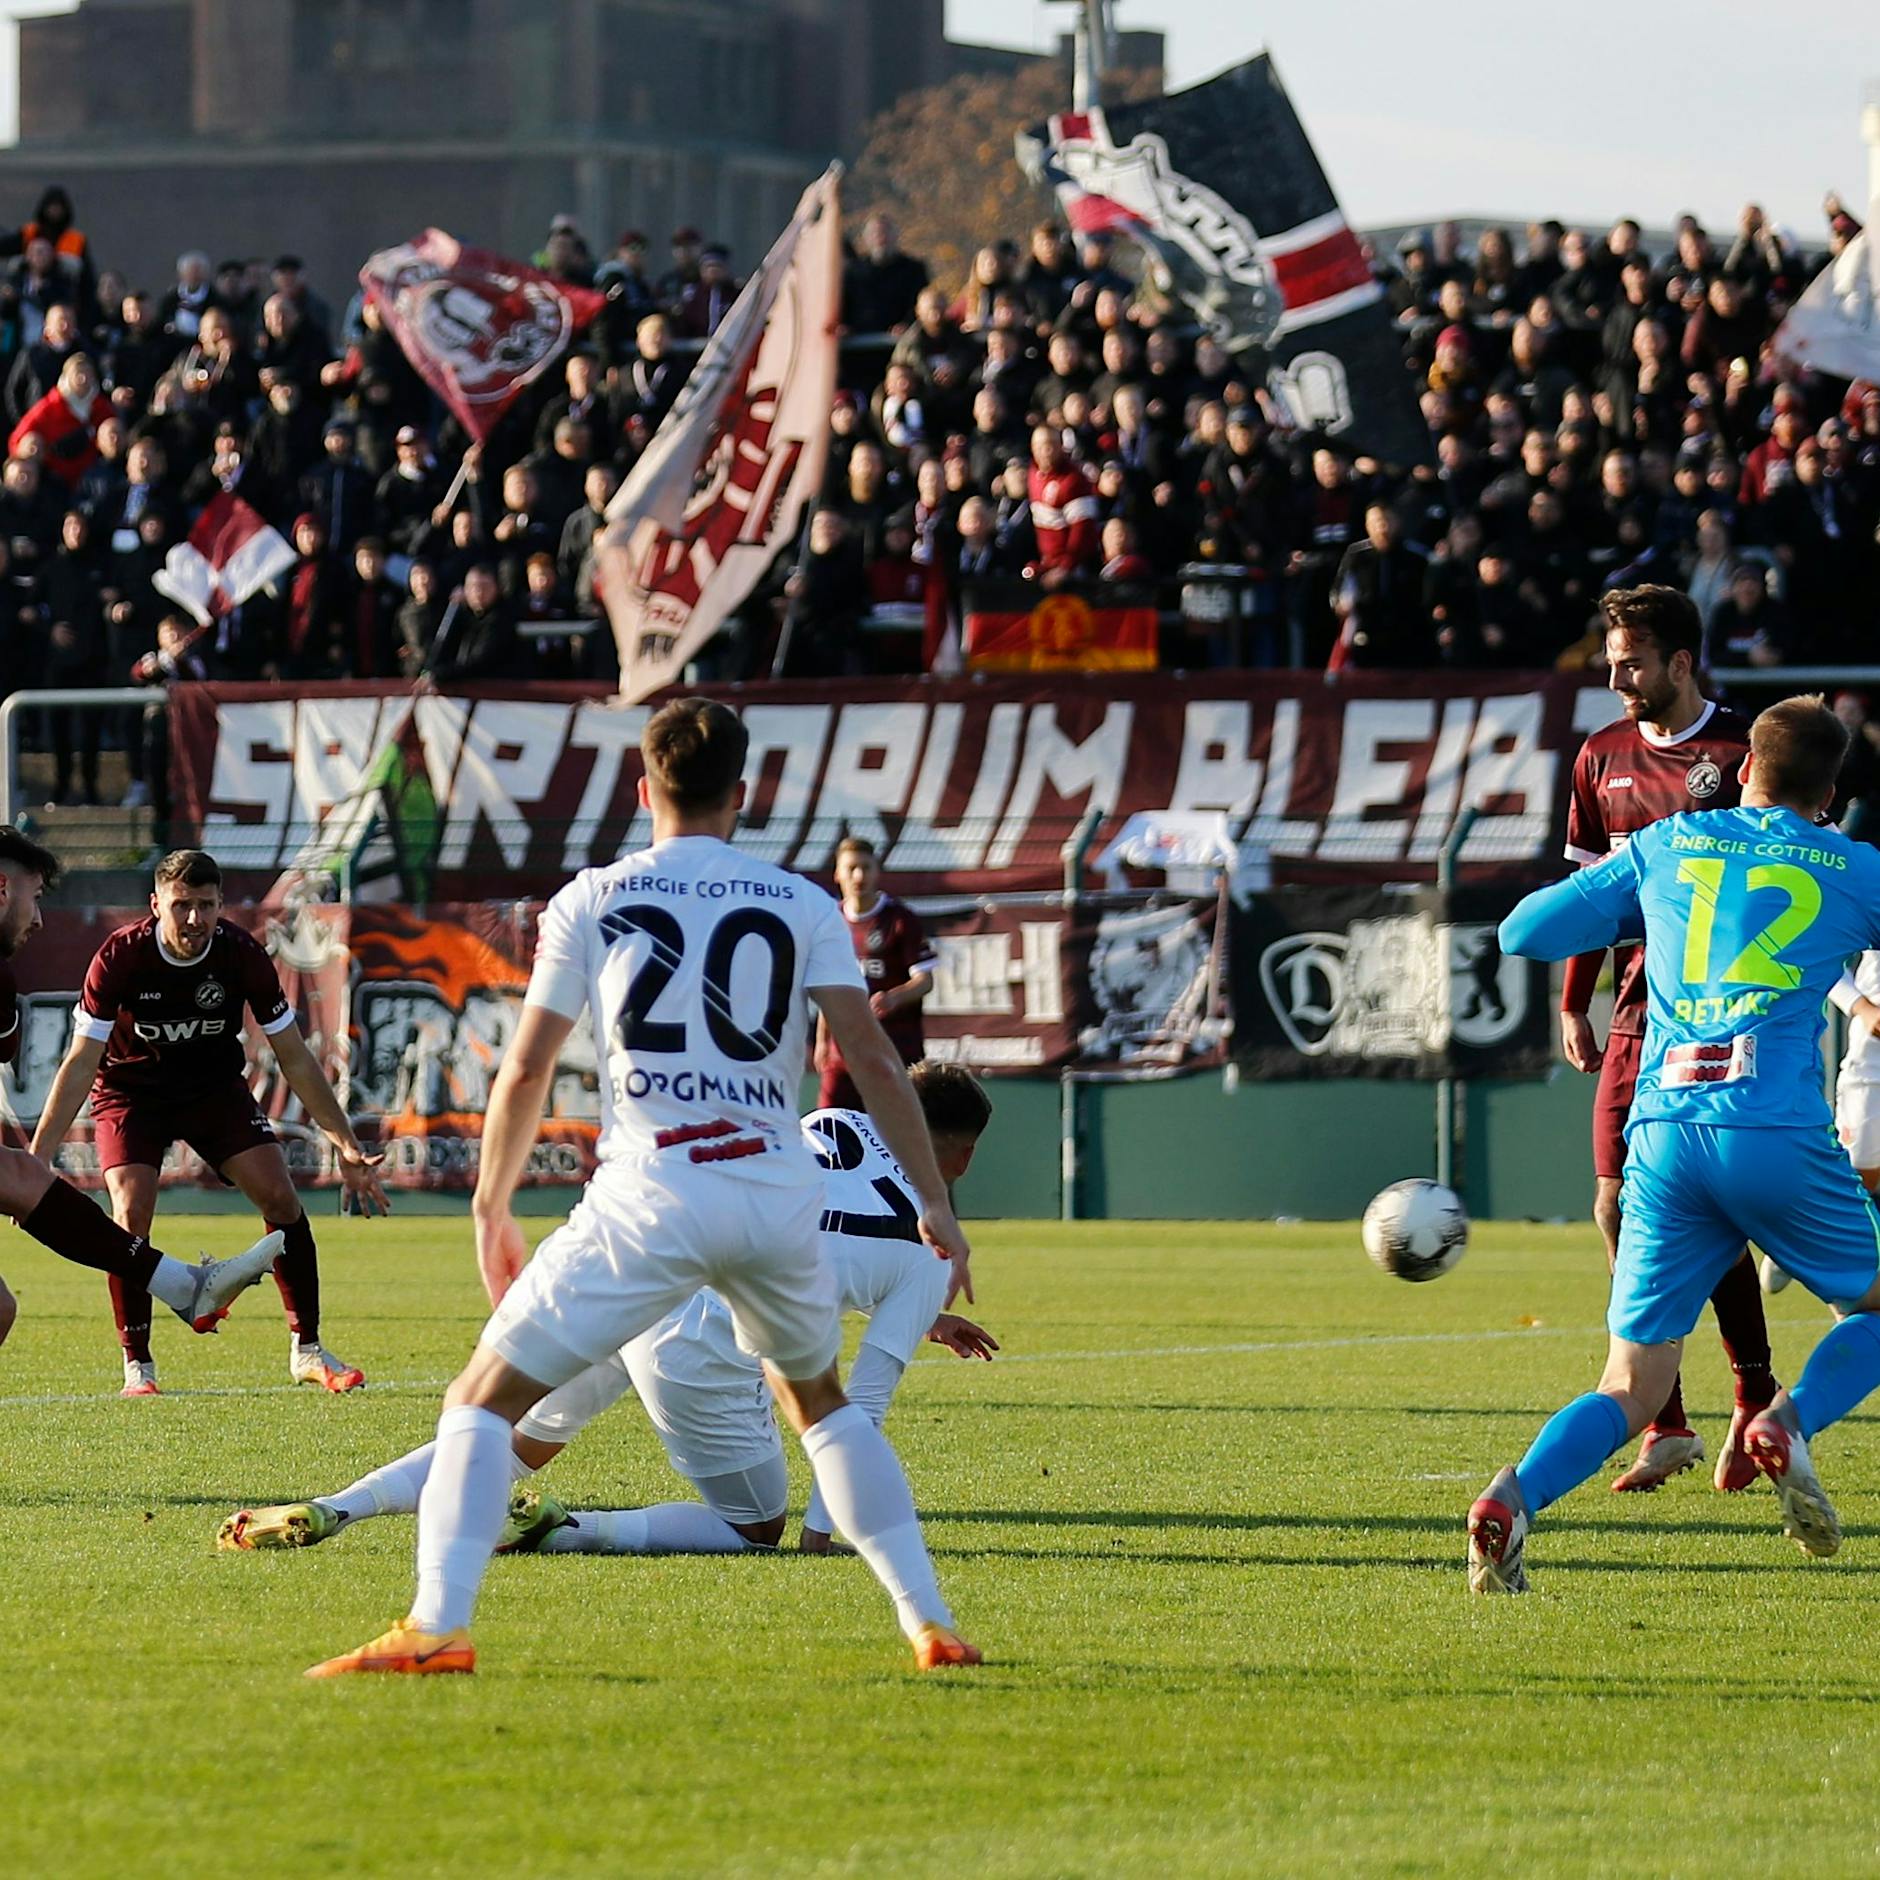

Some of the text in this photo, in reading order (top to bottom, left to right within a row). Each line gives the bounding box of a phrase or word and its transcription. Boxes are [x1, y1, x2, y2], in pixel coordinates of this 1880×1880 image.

[1607, 776, 1633, 790] JAKO
[1671, 835, 1847, 870] ENERGIE COTTBUS
[602, 875, 795, 899] ENERGIE COTTBUS
[1676, 858, 1822, 990] 12
[139, 991, 162, 1000] JAKO
[598, 904, 796, 1062] 20
[611, 1068, 787, 1111] BORGMANN
